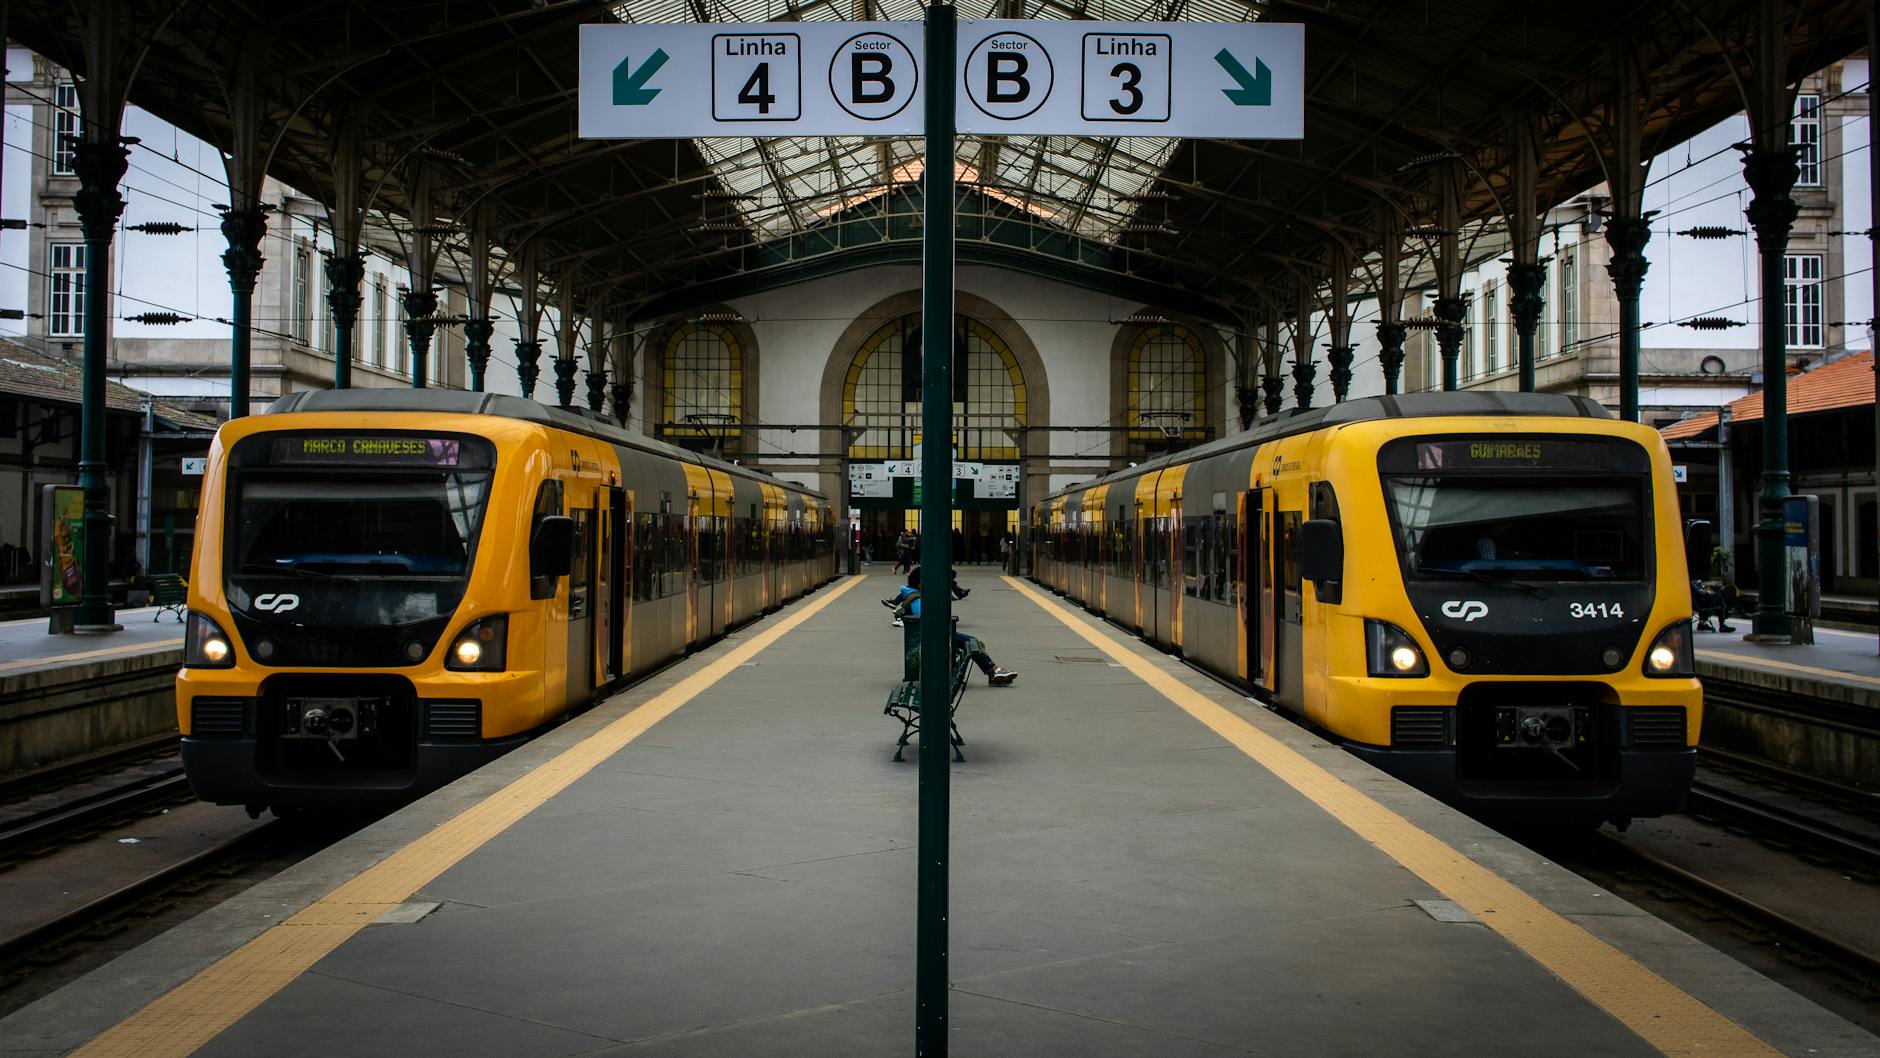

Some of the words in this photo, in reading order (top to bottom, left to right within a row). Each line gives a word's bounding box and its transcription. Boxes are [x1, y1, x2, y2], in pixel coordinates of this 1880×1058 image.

[726, 38, 786, 55] Linha
[855, 41, 892, 50] Sector
[991, 40, 1028, 49] Sector
[1096, 38, 1157, 56] Linha
[852, 52, 895, 104] B
[987, 52, 1031, 103] B
[738, 62, 775, 114] 4
[1109, 62, 1143, 115] 3
[304, 439, 346, 454] MARCO
[1569, 602, 1624, 618] 3414
